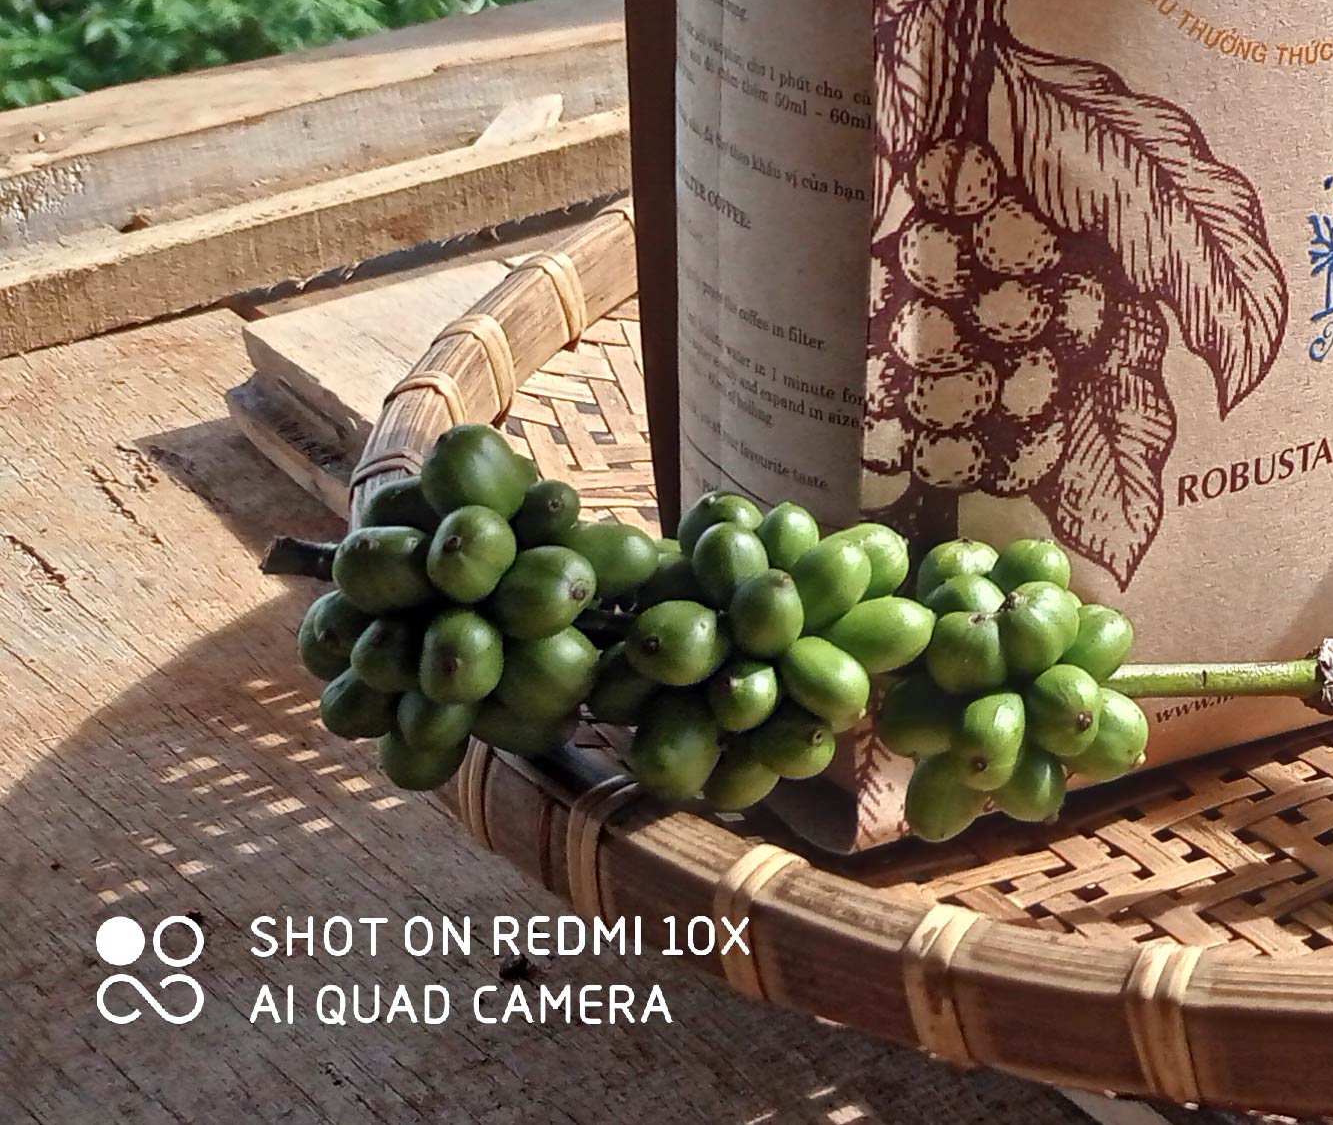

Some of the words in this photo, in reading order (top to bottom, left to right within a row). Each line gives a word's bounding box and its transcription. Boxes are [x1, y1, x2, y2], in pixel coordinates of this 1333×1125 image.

[779, 70, 811, 92] phút
[815, 80, 843, 100] cho
[774, 90, 807, 116] 50ml
[830, 108, 872, 130] 60ml
[785, 170, 798, 189] vị
[802, 173, 828, 193] của
[738, 306, 769, 332] coffee
[772, 324, 784, 339] in
[760, 387, 805, 416] expand
[808, 406, 823, 421] in
[784, 375, 835, 400] minute
[842, 386, 866, 406] for
[1177, 437, 1333, 506] ROBUSTA
